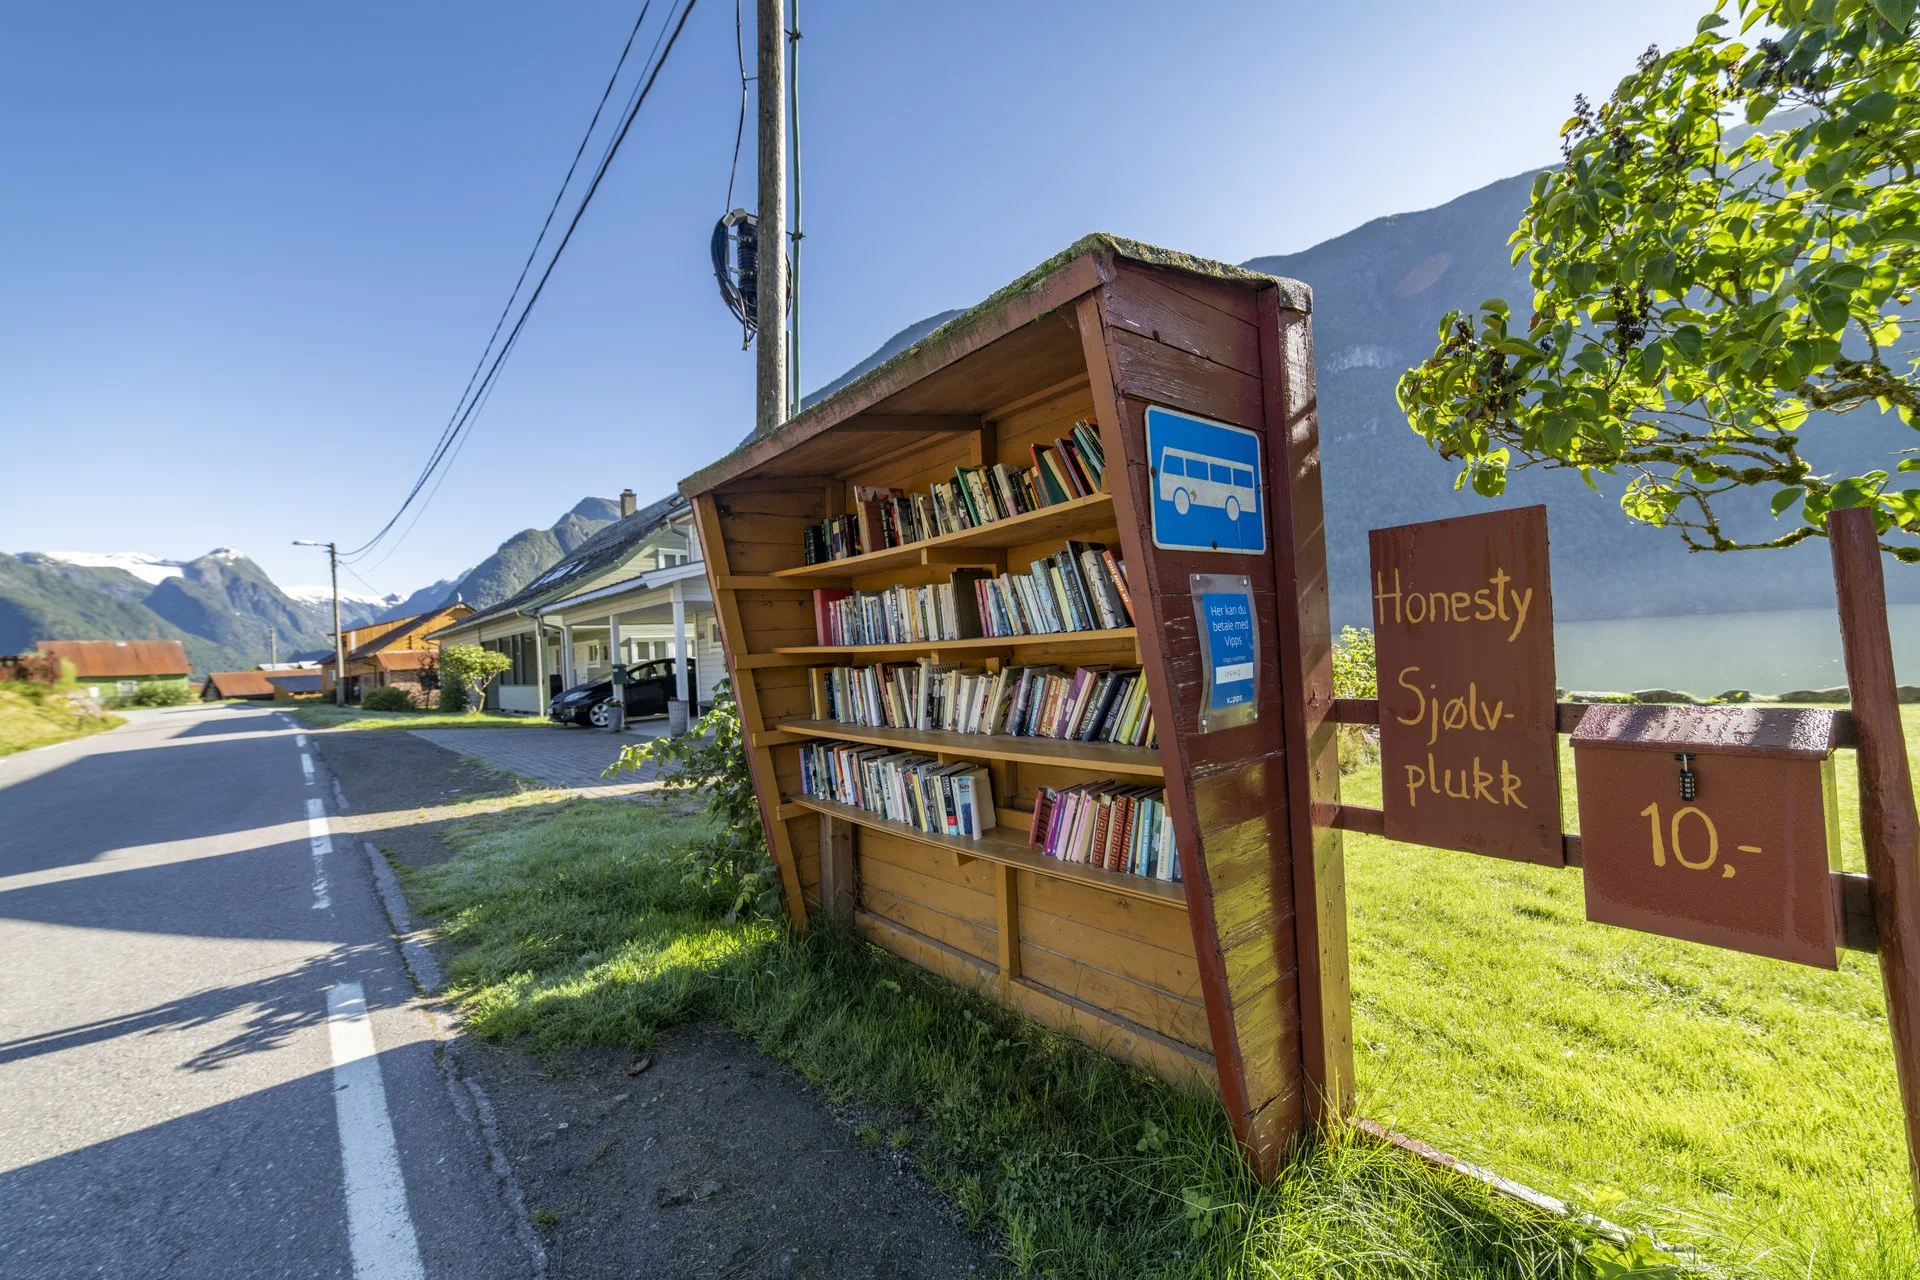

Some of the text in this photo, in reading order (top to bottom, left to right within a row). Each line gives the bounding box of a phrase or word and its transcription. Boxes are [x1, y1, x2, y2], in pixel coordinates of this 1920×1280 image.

[1210, 604, 1247, 617] Her kan du
[1374, 567, 1533, 642] Honesty
[1212, 619, 1249, 632] betale med
[1224, 635, 1242, 648] Vipps
[1397, 666, 1515, 746] Sjølv-
[1404, 752, 1528, 809] plukk
